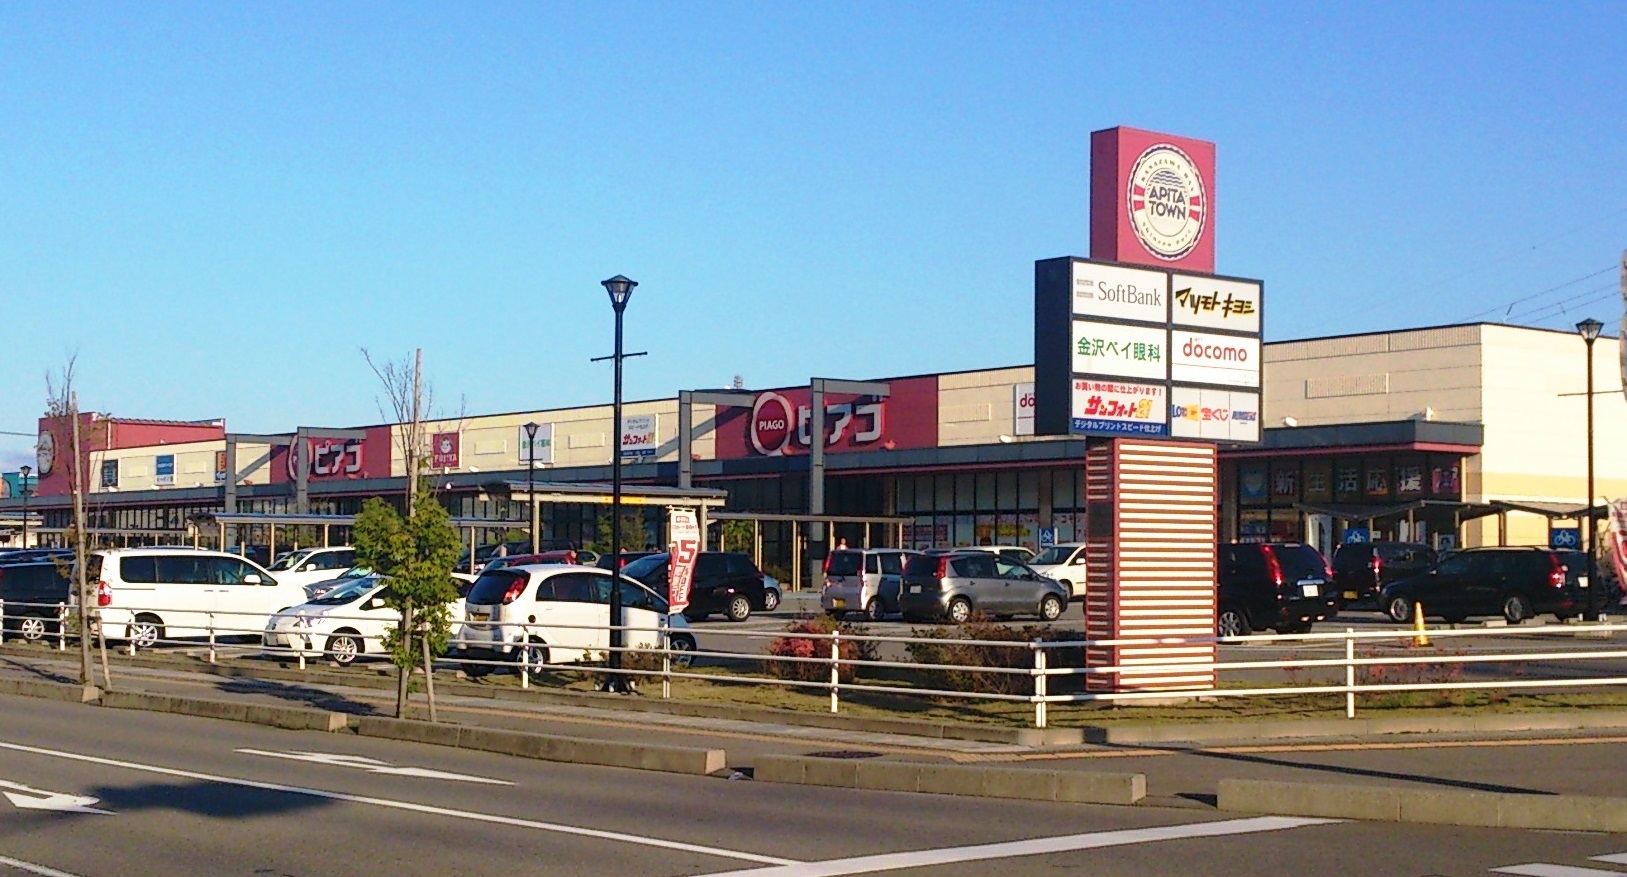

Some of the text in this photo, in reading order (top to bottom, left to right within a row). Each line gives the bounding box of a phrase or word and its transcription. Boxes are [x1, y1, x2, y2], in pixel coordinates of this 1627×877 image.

[1149, 186, 1186, 205] APITA
[1149, 200, 1186, 220] TOWN
[1098, 281, 1162, 307] SoftBank
[1175, 287, 1255, 318] マツモトキヨシ
[1077, 336, 1160, 363] 金沢ベイ眼科
[1183, 337, 1248, 362] docomo
[759, 420, 785, 431] PIAGO
[315, 439, 363, 474] ピアゴ
